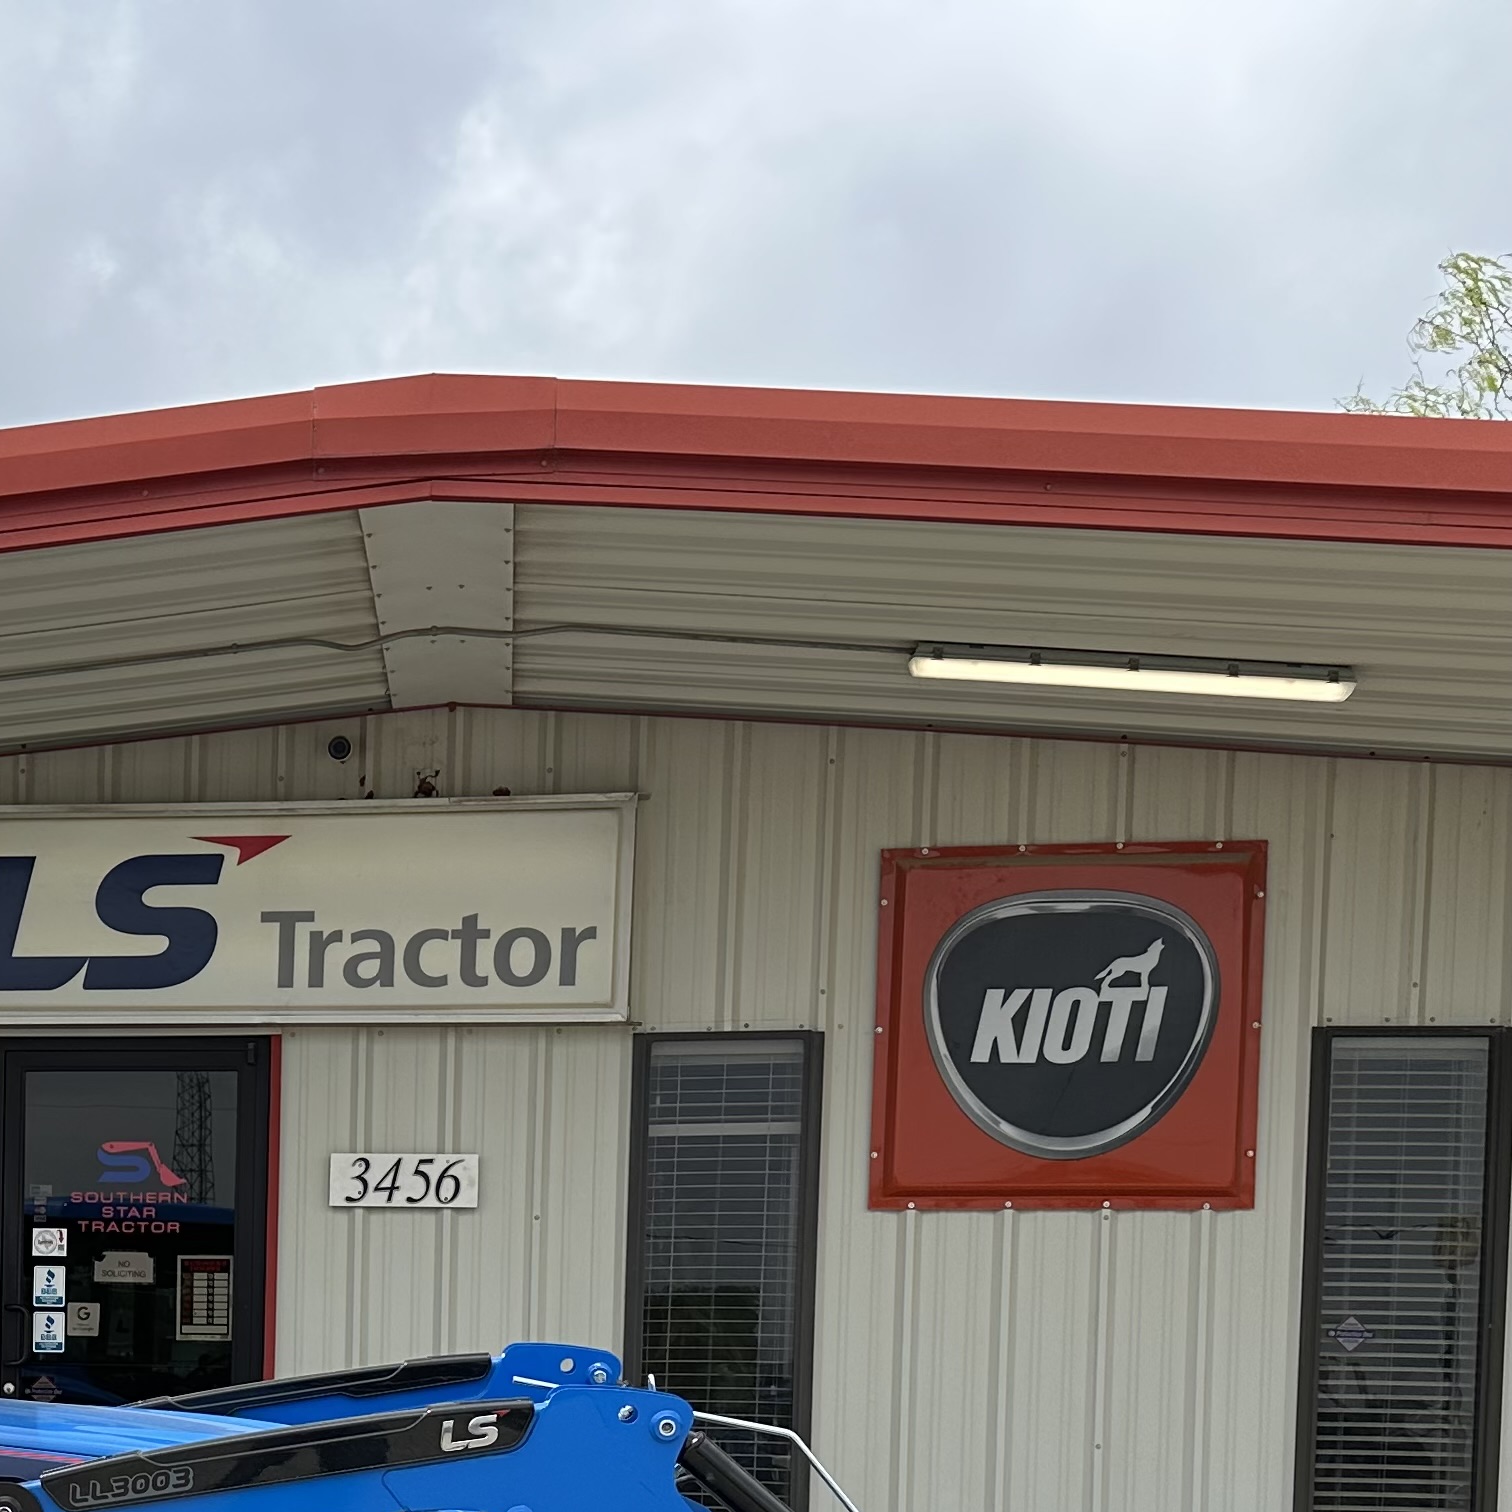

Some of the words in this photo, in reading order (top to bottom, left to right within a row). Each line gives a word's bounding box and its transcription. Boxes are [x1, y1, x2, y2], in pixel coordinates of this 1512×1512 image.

[260, 910, 598, 989] Tractor
[970, 986, 1169, 1064] KIOTI
[345, 1157, 466, 1204] 3456
[70, 1191, 189, 1204] SOUTHERN
[101, 1206, 156, 1219] STAR
[77, 1220, 181, 1234] TRACTOR
[101, 1269, 147, 1279] SOLICITING
[117, 1260, 131, 1268] NO
[440, 1413, 499, 1452] LS
[68, 1465, 194, 1507] LL3003
